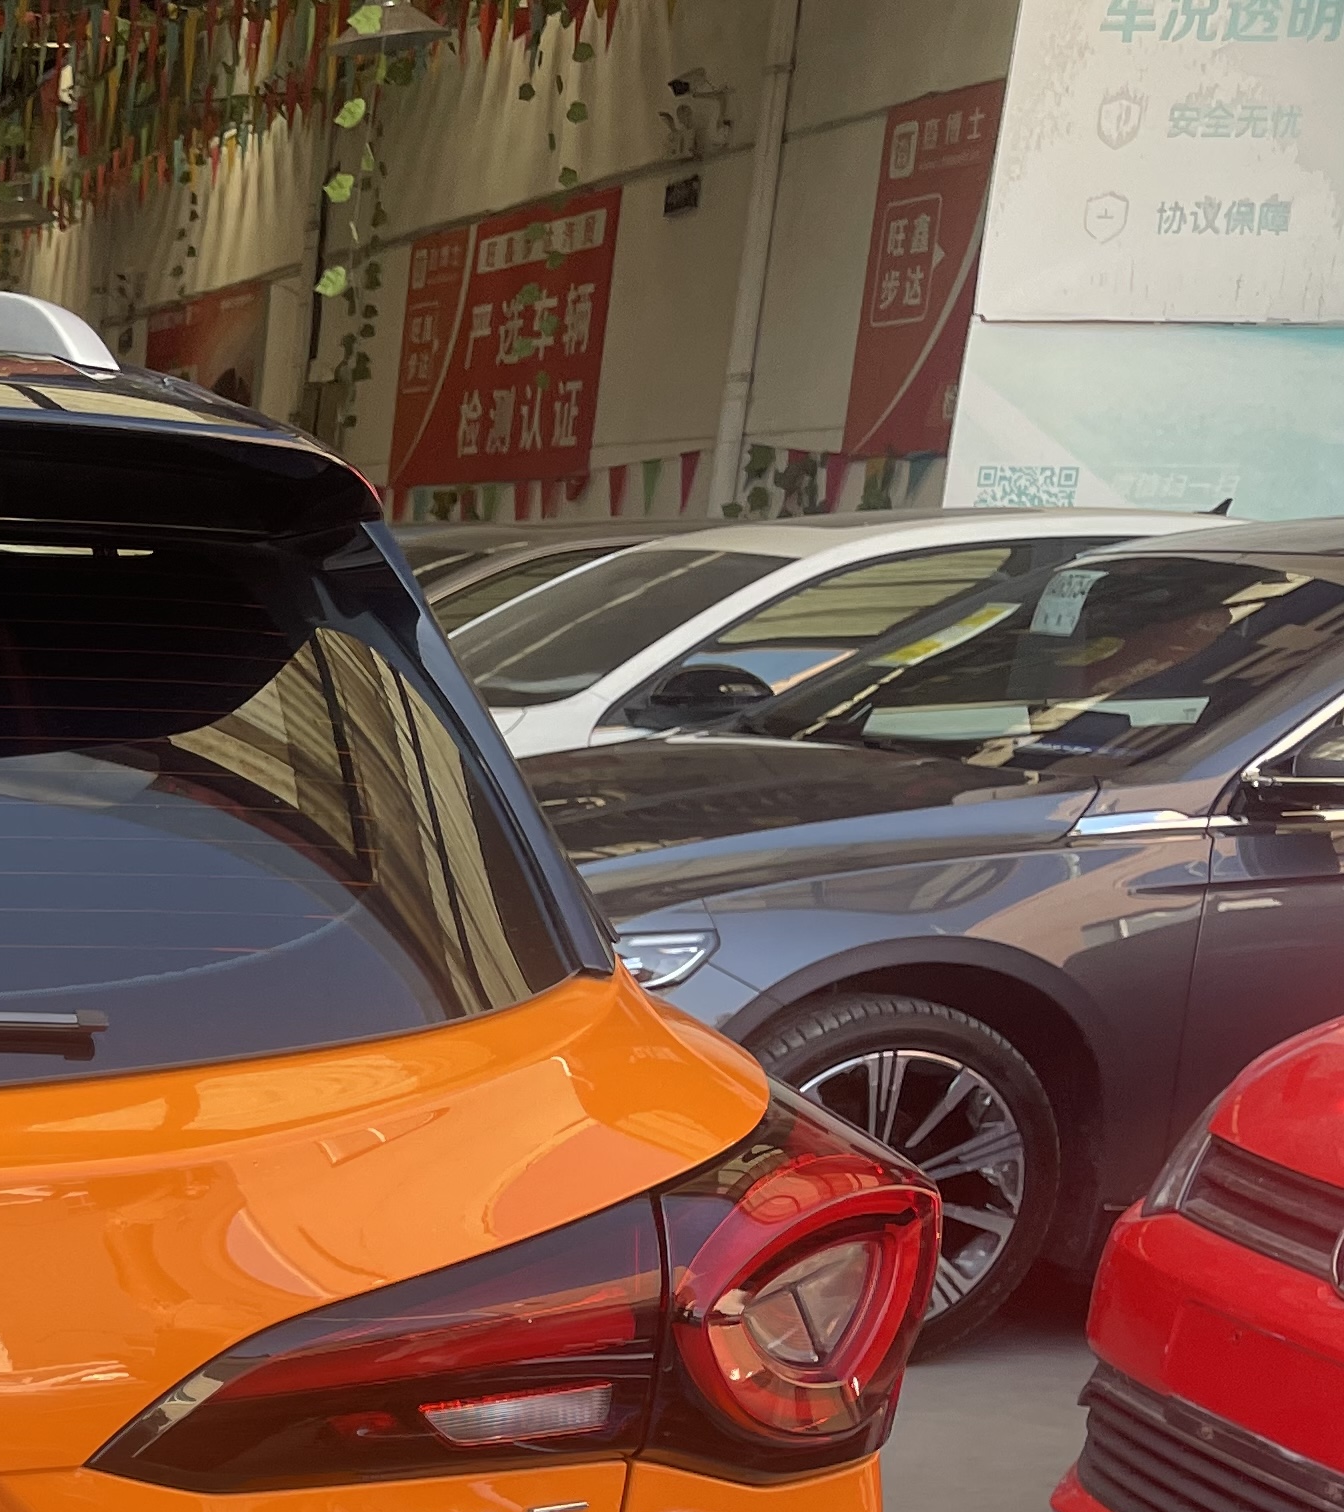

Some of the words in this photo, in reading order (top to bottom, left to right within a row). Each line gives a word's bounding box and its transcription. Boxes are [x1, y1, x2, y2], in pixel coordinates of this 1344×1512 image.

[1167, 101, 1303, 138] 安全无忧
[1157, 197, 1292, 235] 协议保障
[458, 380, 583, 458] 检测认证
